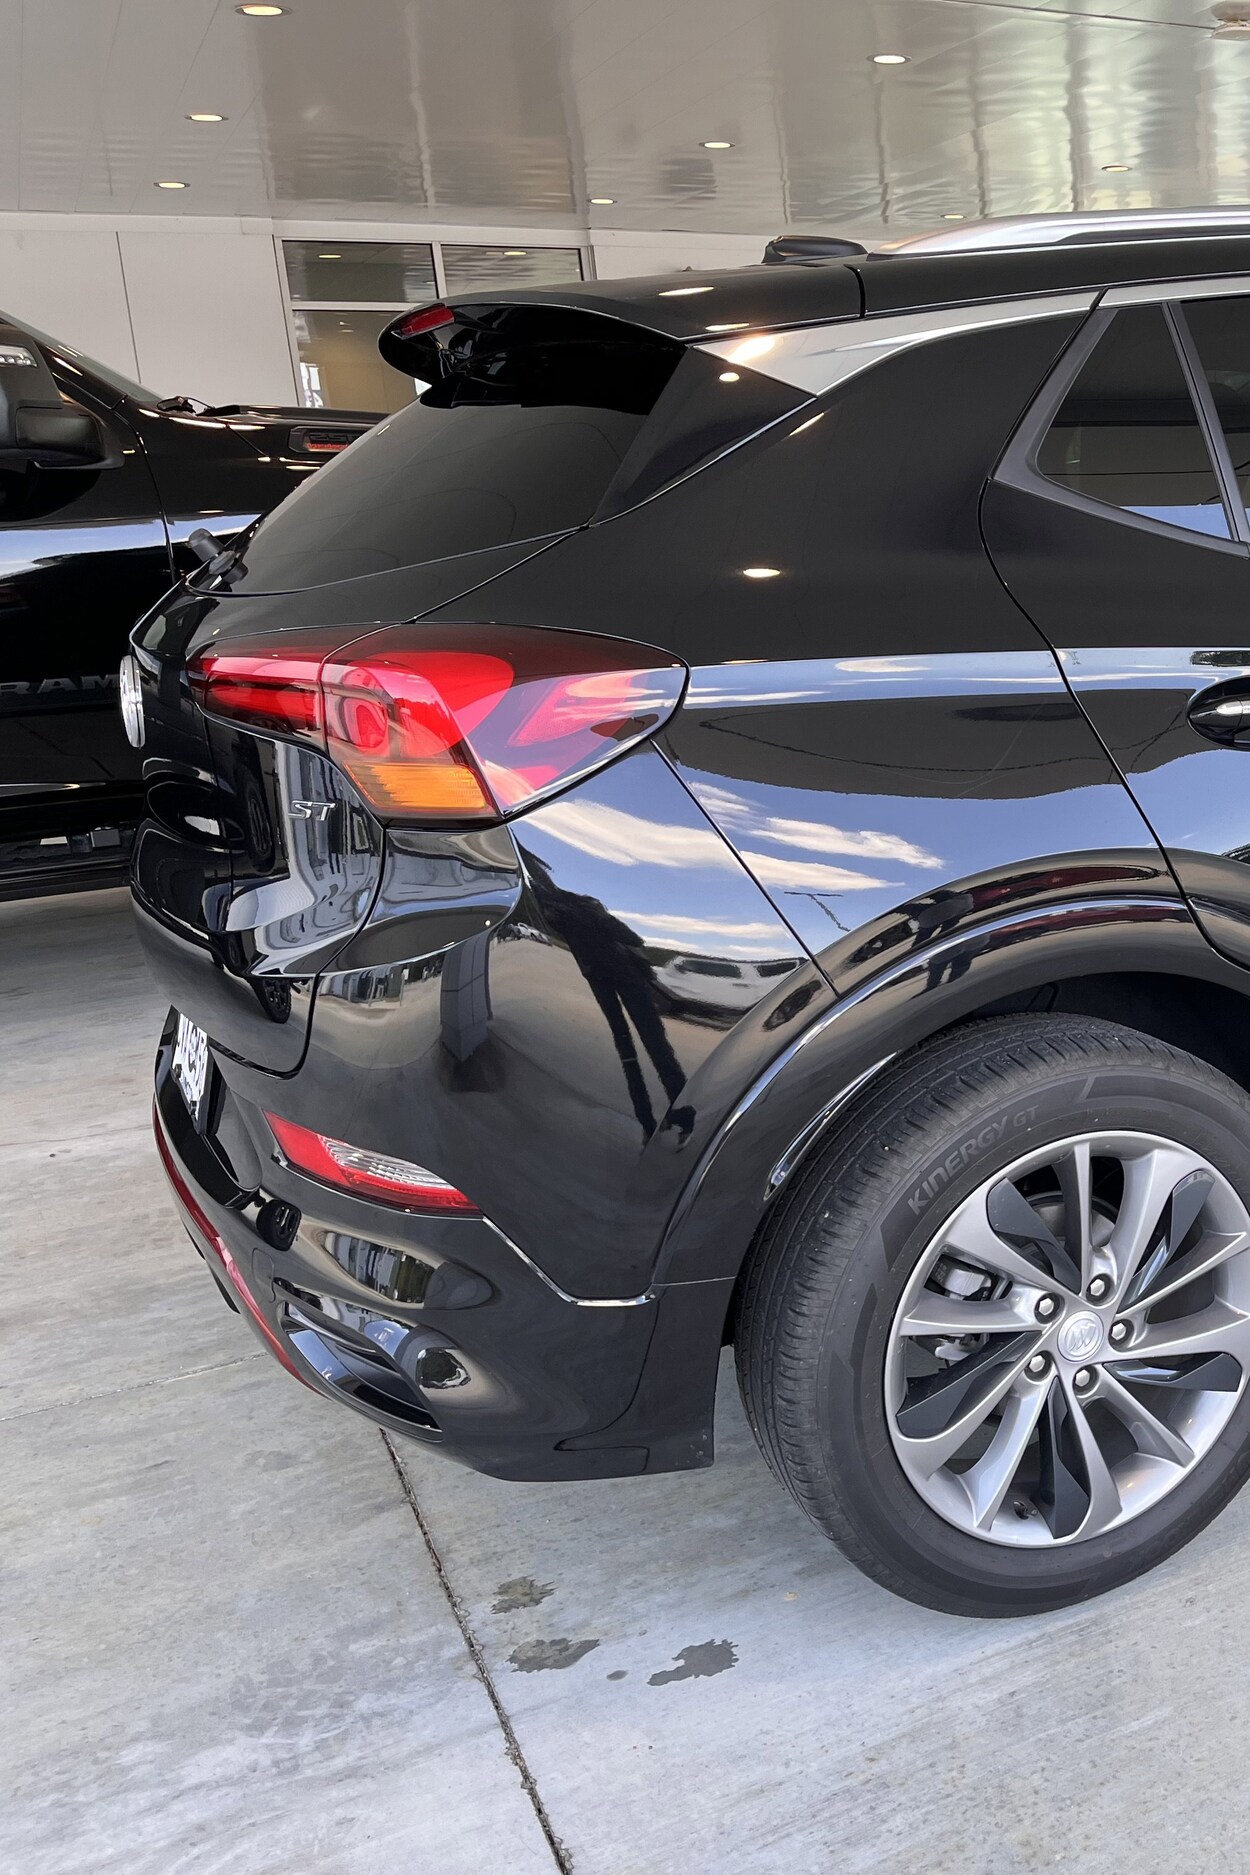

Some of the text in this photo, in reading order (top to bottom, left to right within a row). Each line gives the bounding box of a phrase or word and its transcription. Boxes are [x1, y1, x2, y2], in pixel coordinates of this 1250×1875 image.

[0, 674, 121, 694] RAM
[288, 800, 336, 821] ST
[907, 1105, 1039, 1216] KINERGY GT
